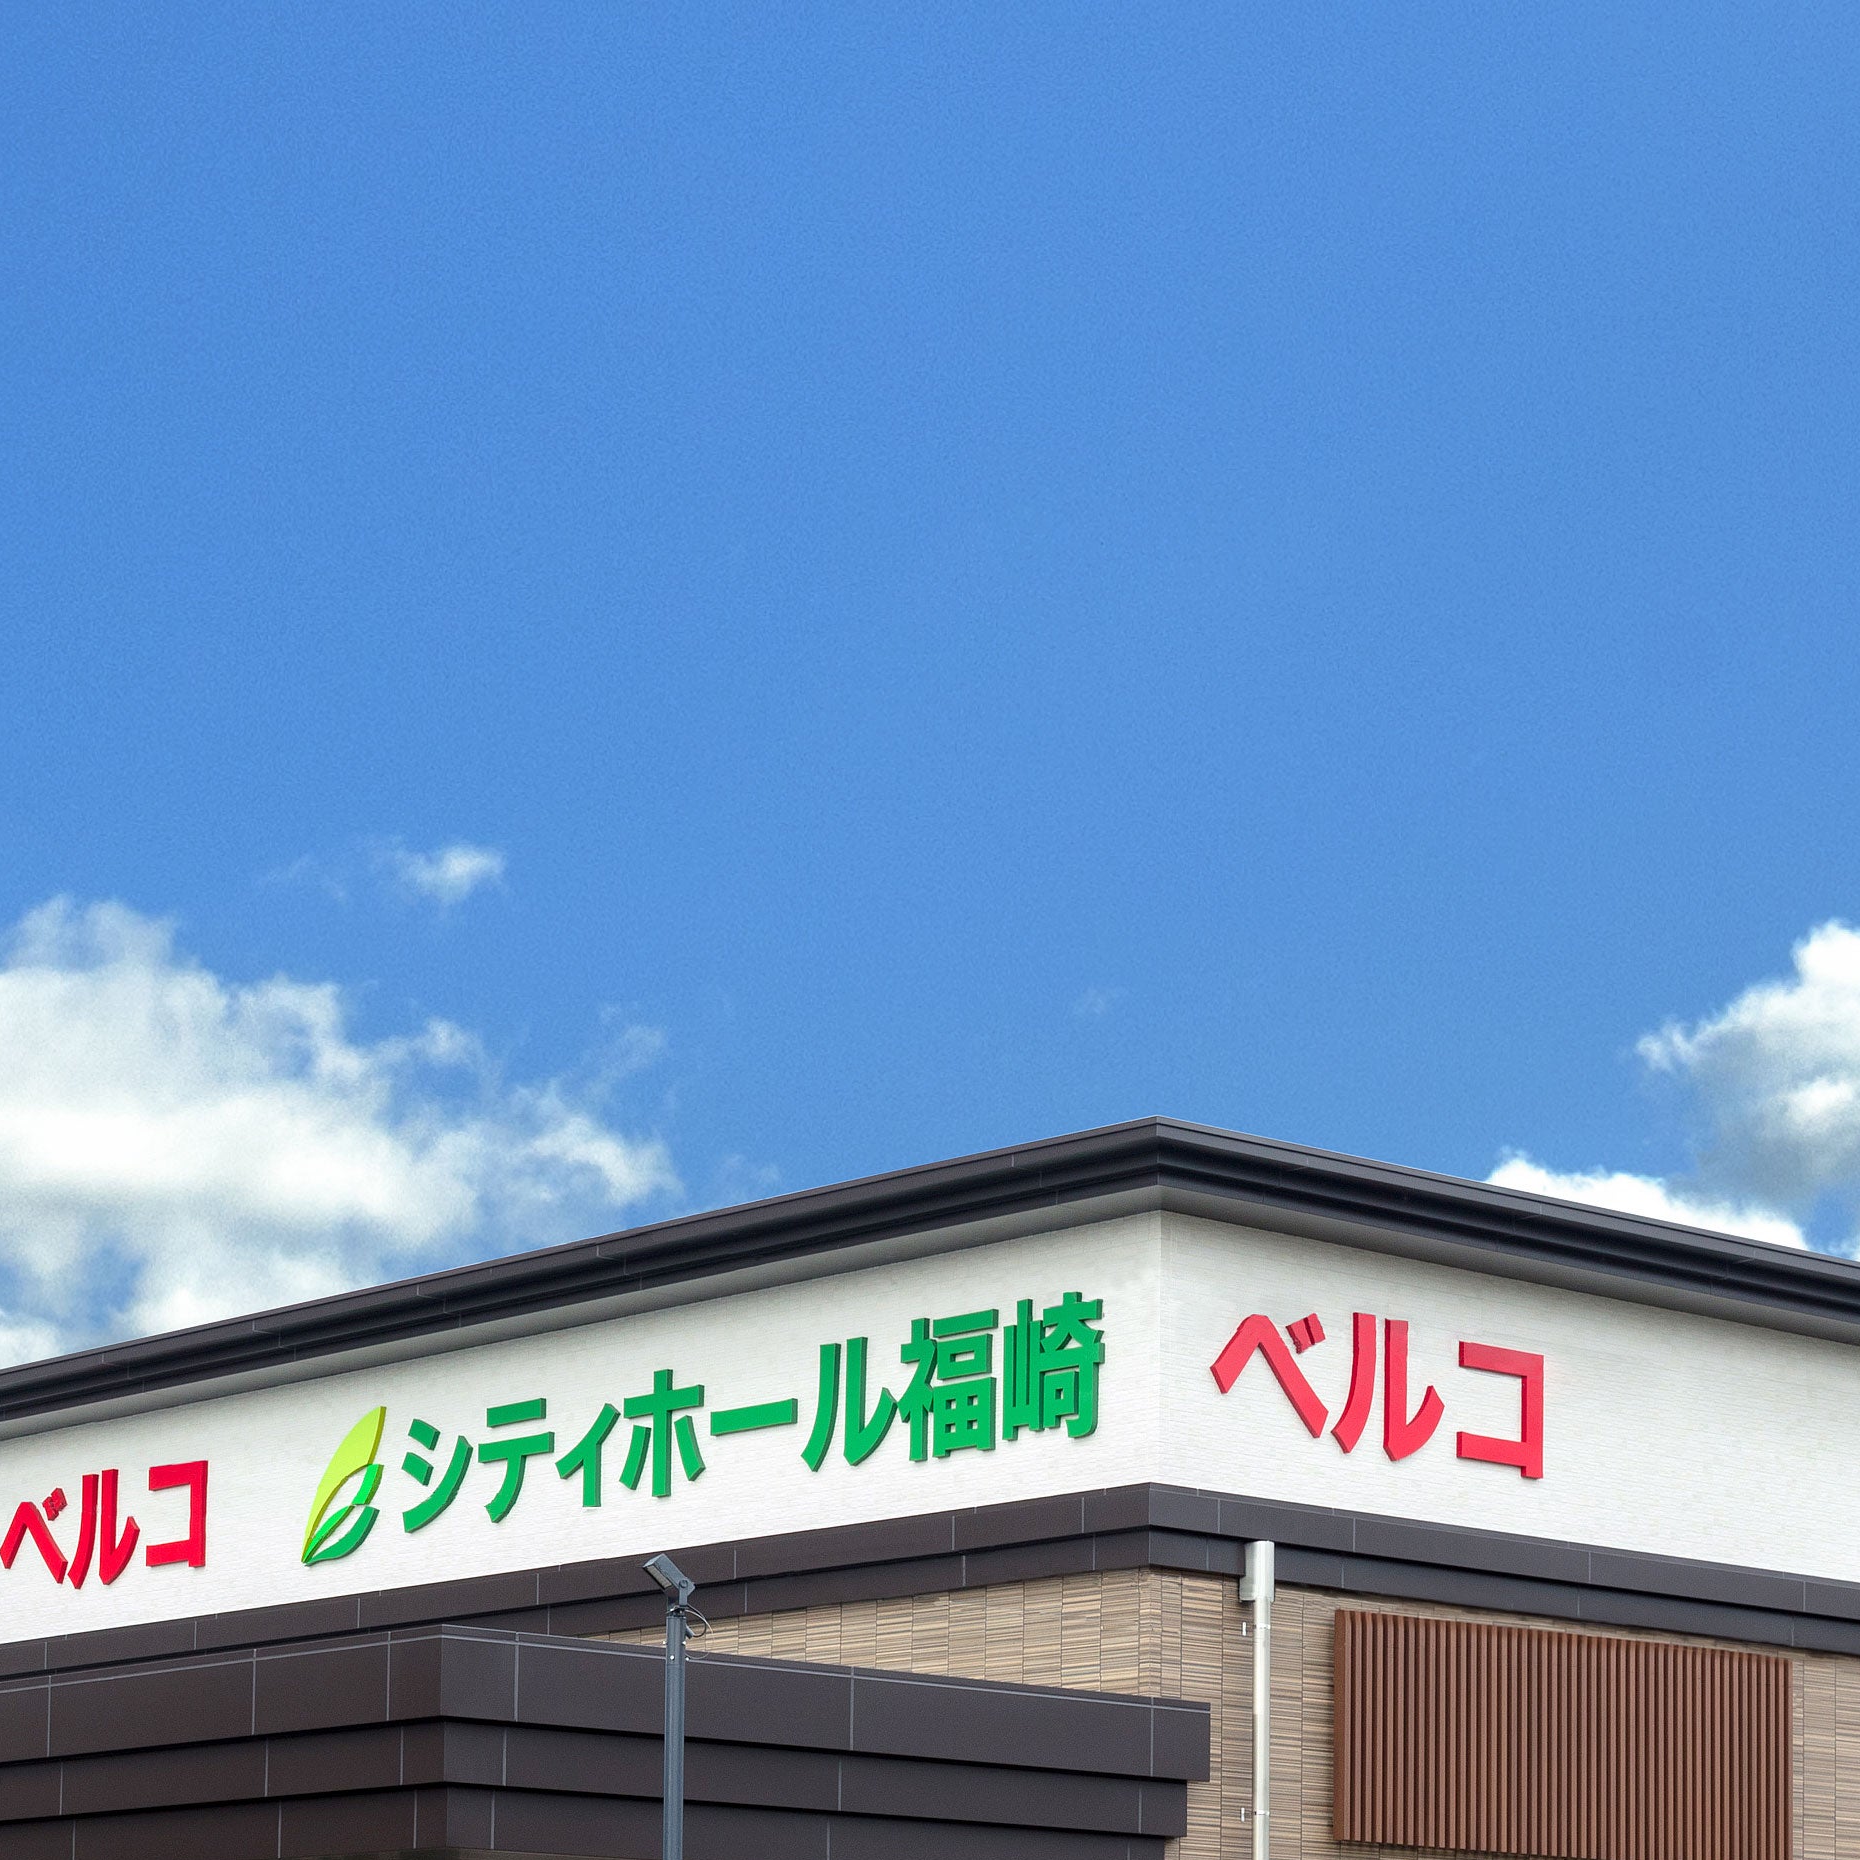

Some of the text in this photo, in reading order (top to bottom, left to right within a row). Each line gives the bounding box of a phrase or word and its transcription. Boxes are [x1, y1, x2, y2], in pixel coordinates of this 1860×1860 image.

[400, 1291, 1105, 1533] シティホール福崎
[1209, 1311, 1545, 1480] ベルコ
